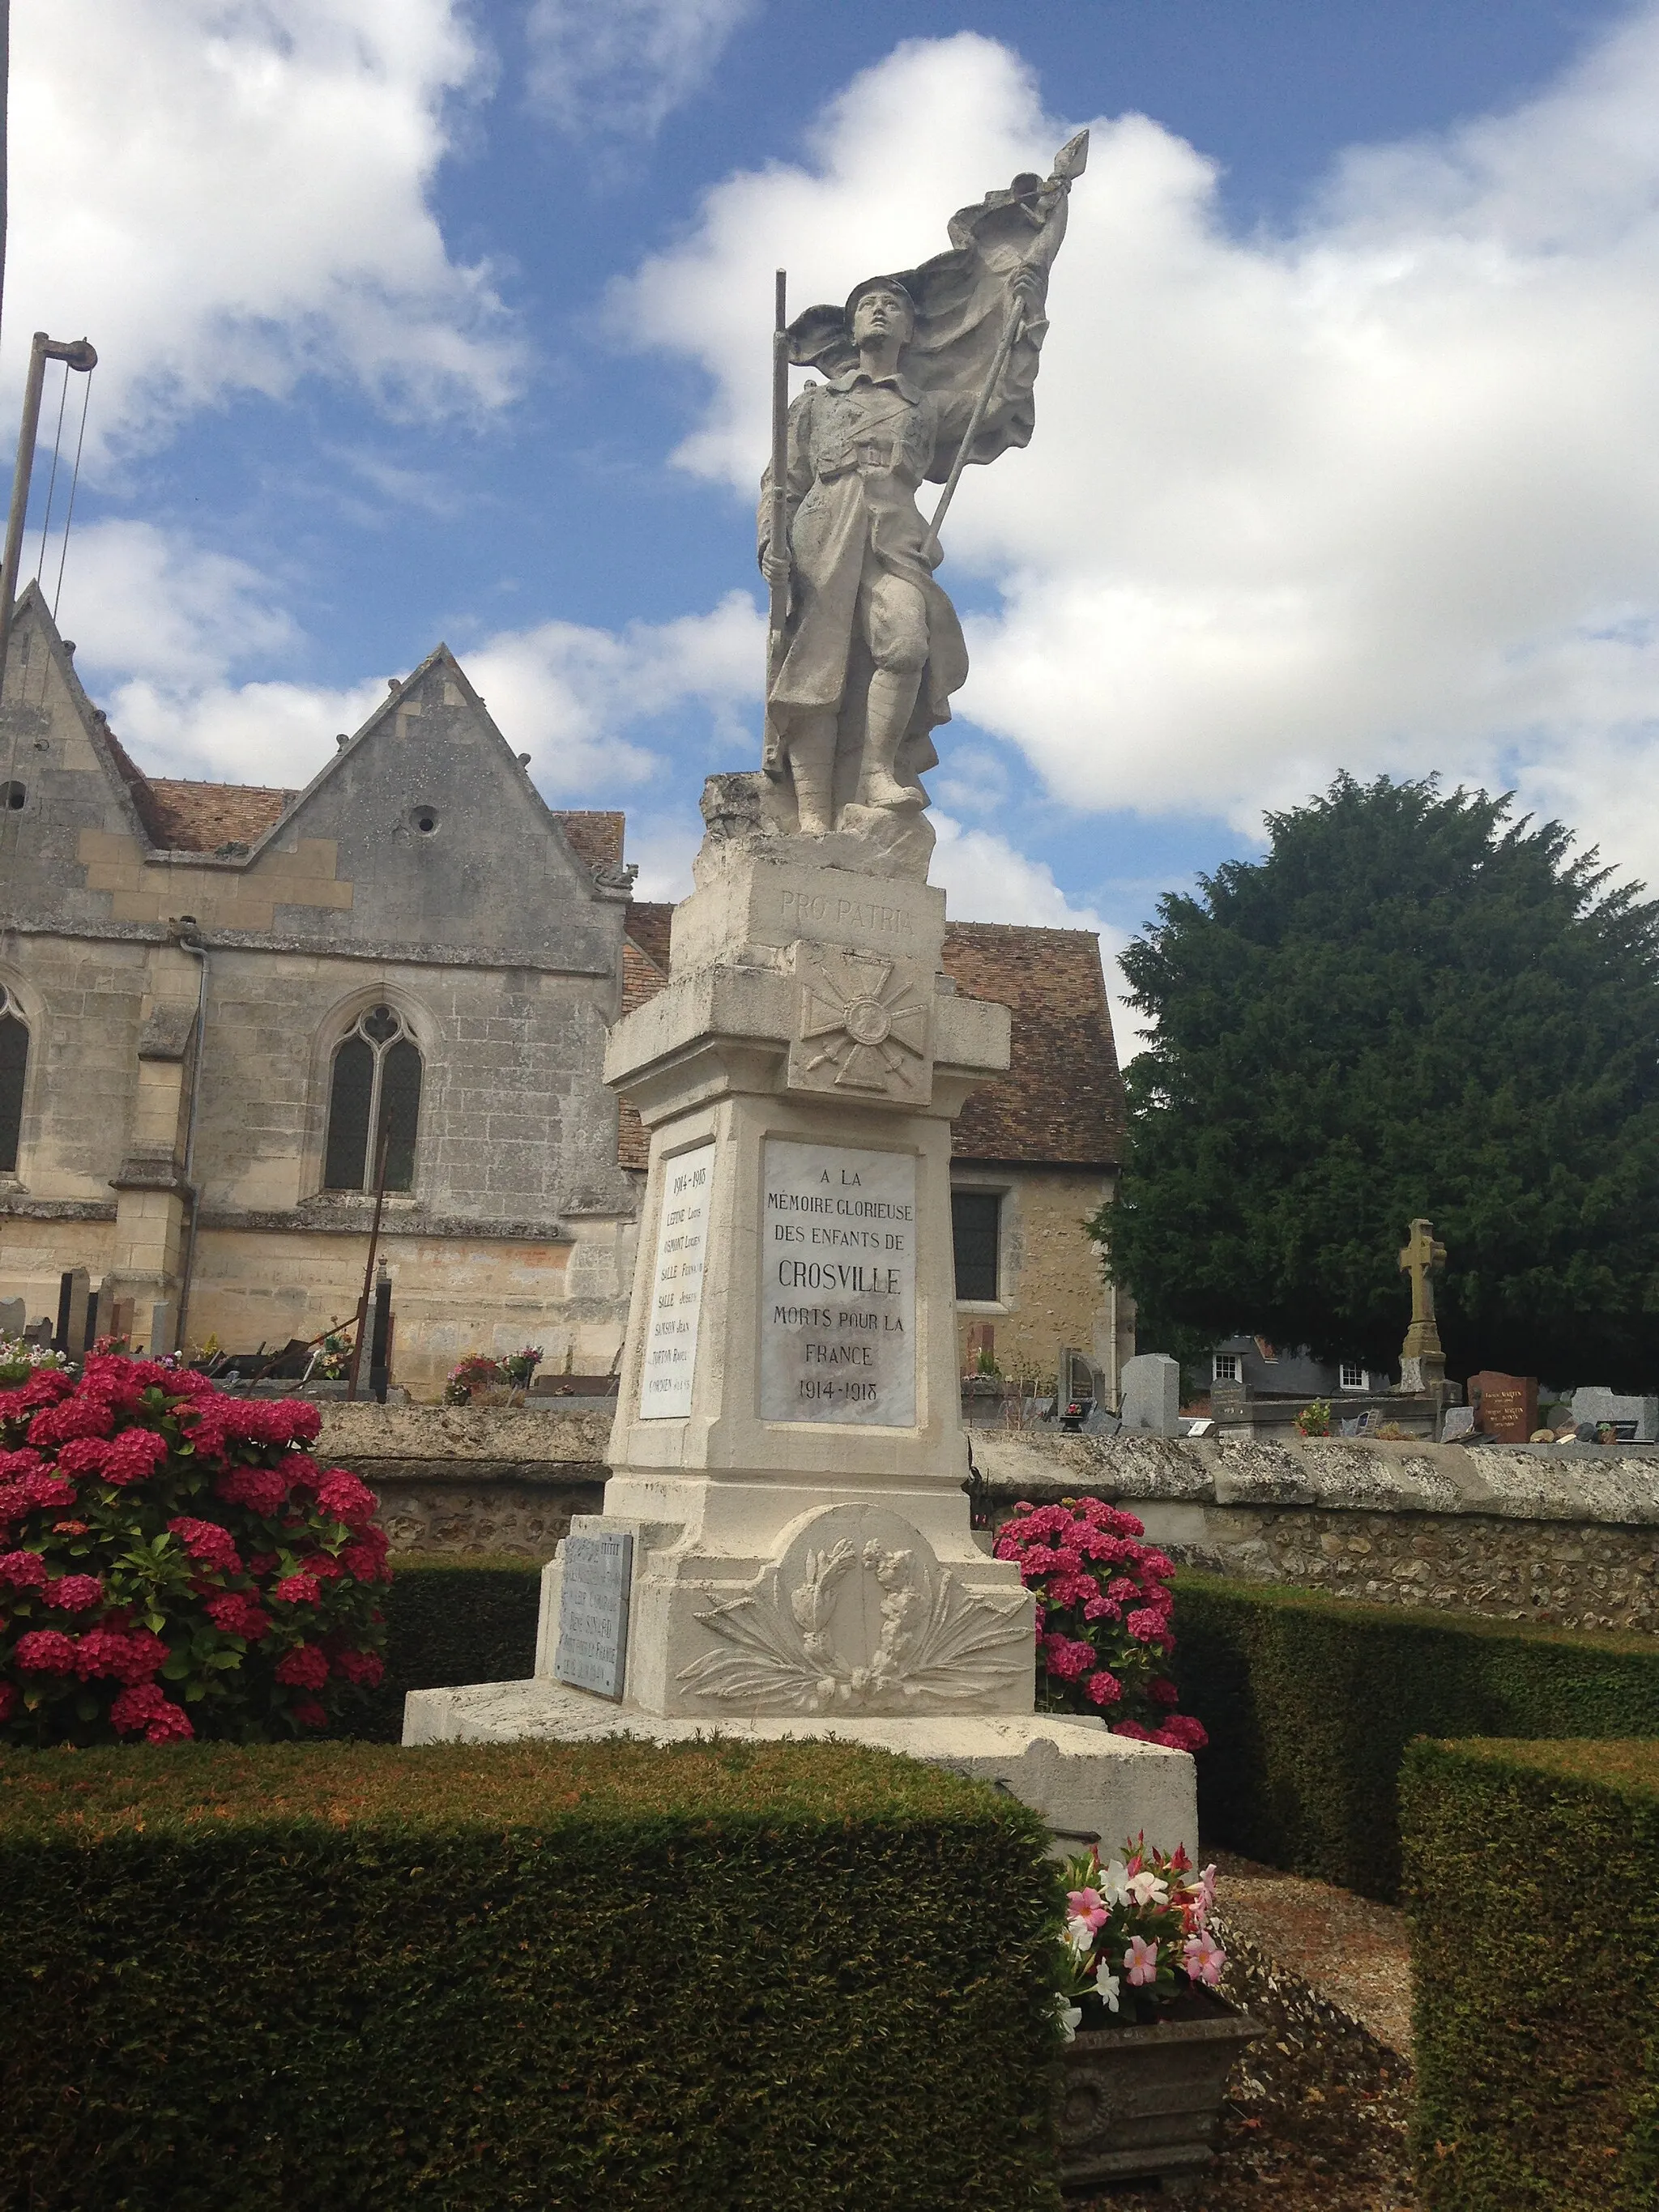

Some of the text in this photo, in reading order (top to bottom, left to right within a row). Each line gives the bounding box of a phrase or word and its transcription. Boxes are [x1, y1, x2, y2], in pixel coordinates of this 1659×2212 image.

[781, 890, 915, 936] PRO PATRIA
[820, 1169, 862, 1187] A LA
[768, 1190, 913, 1221] MÉMOIRE GLORIEUSE
[774, 1225, 905, 1251] DES ENFANTS DE
[778, 1259, 901, 1295] CROSVILLE
[774, 1306, 904, 1332] MORTS POUR LA
[805, 1344, 873, 1366] FRANCE
